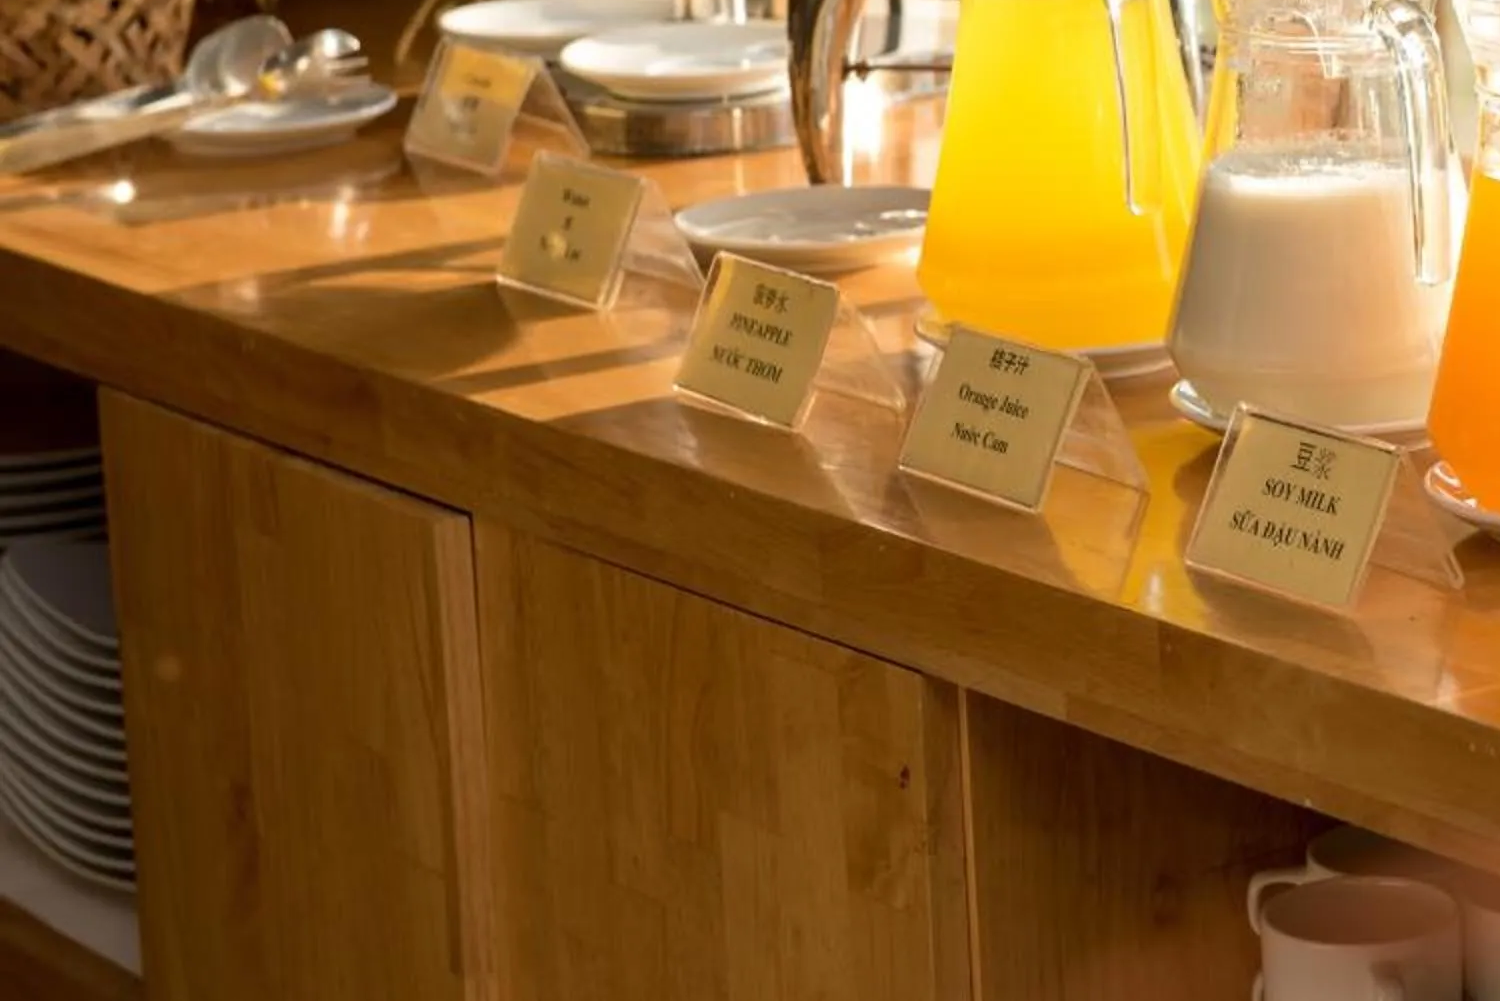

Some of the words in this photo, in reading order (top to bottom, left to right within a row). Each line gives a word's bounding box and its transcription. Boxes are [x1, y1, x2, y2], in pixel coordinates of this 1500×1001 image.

[729, 312, 793, 347] PINEAPPLE
[958, 382, 999, 412] Orange
[999, 395, 1030, 420] Juice
[1261, 478, 1296, 502] SOY
[1296, 485, 1341, 516] MILK
